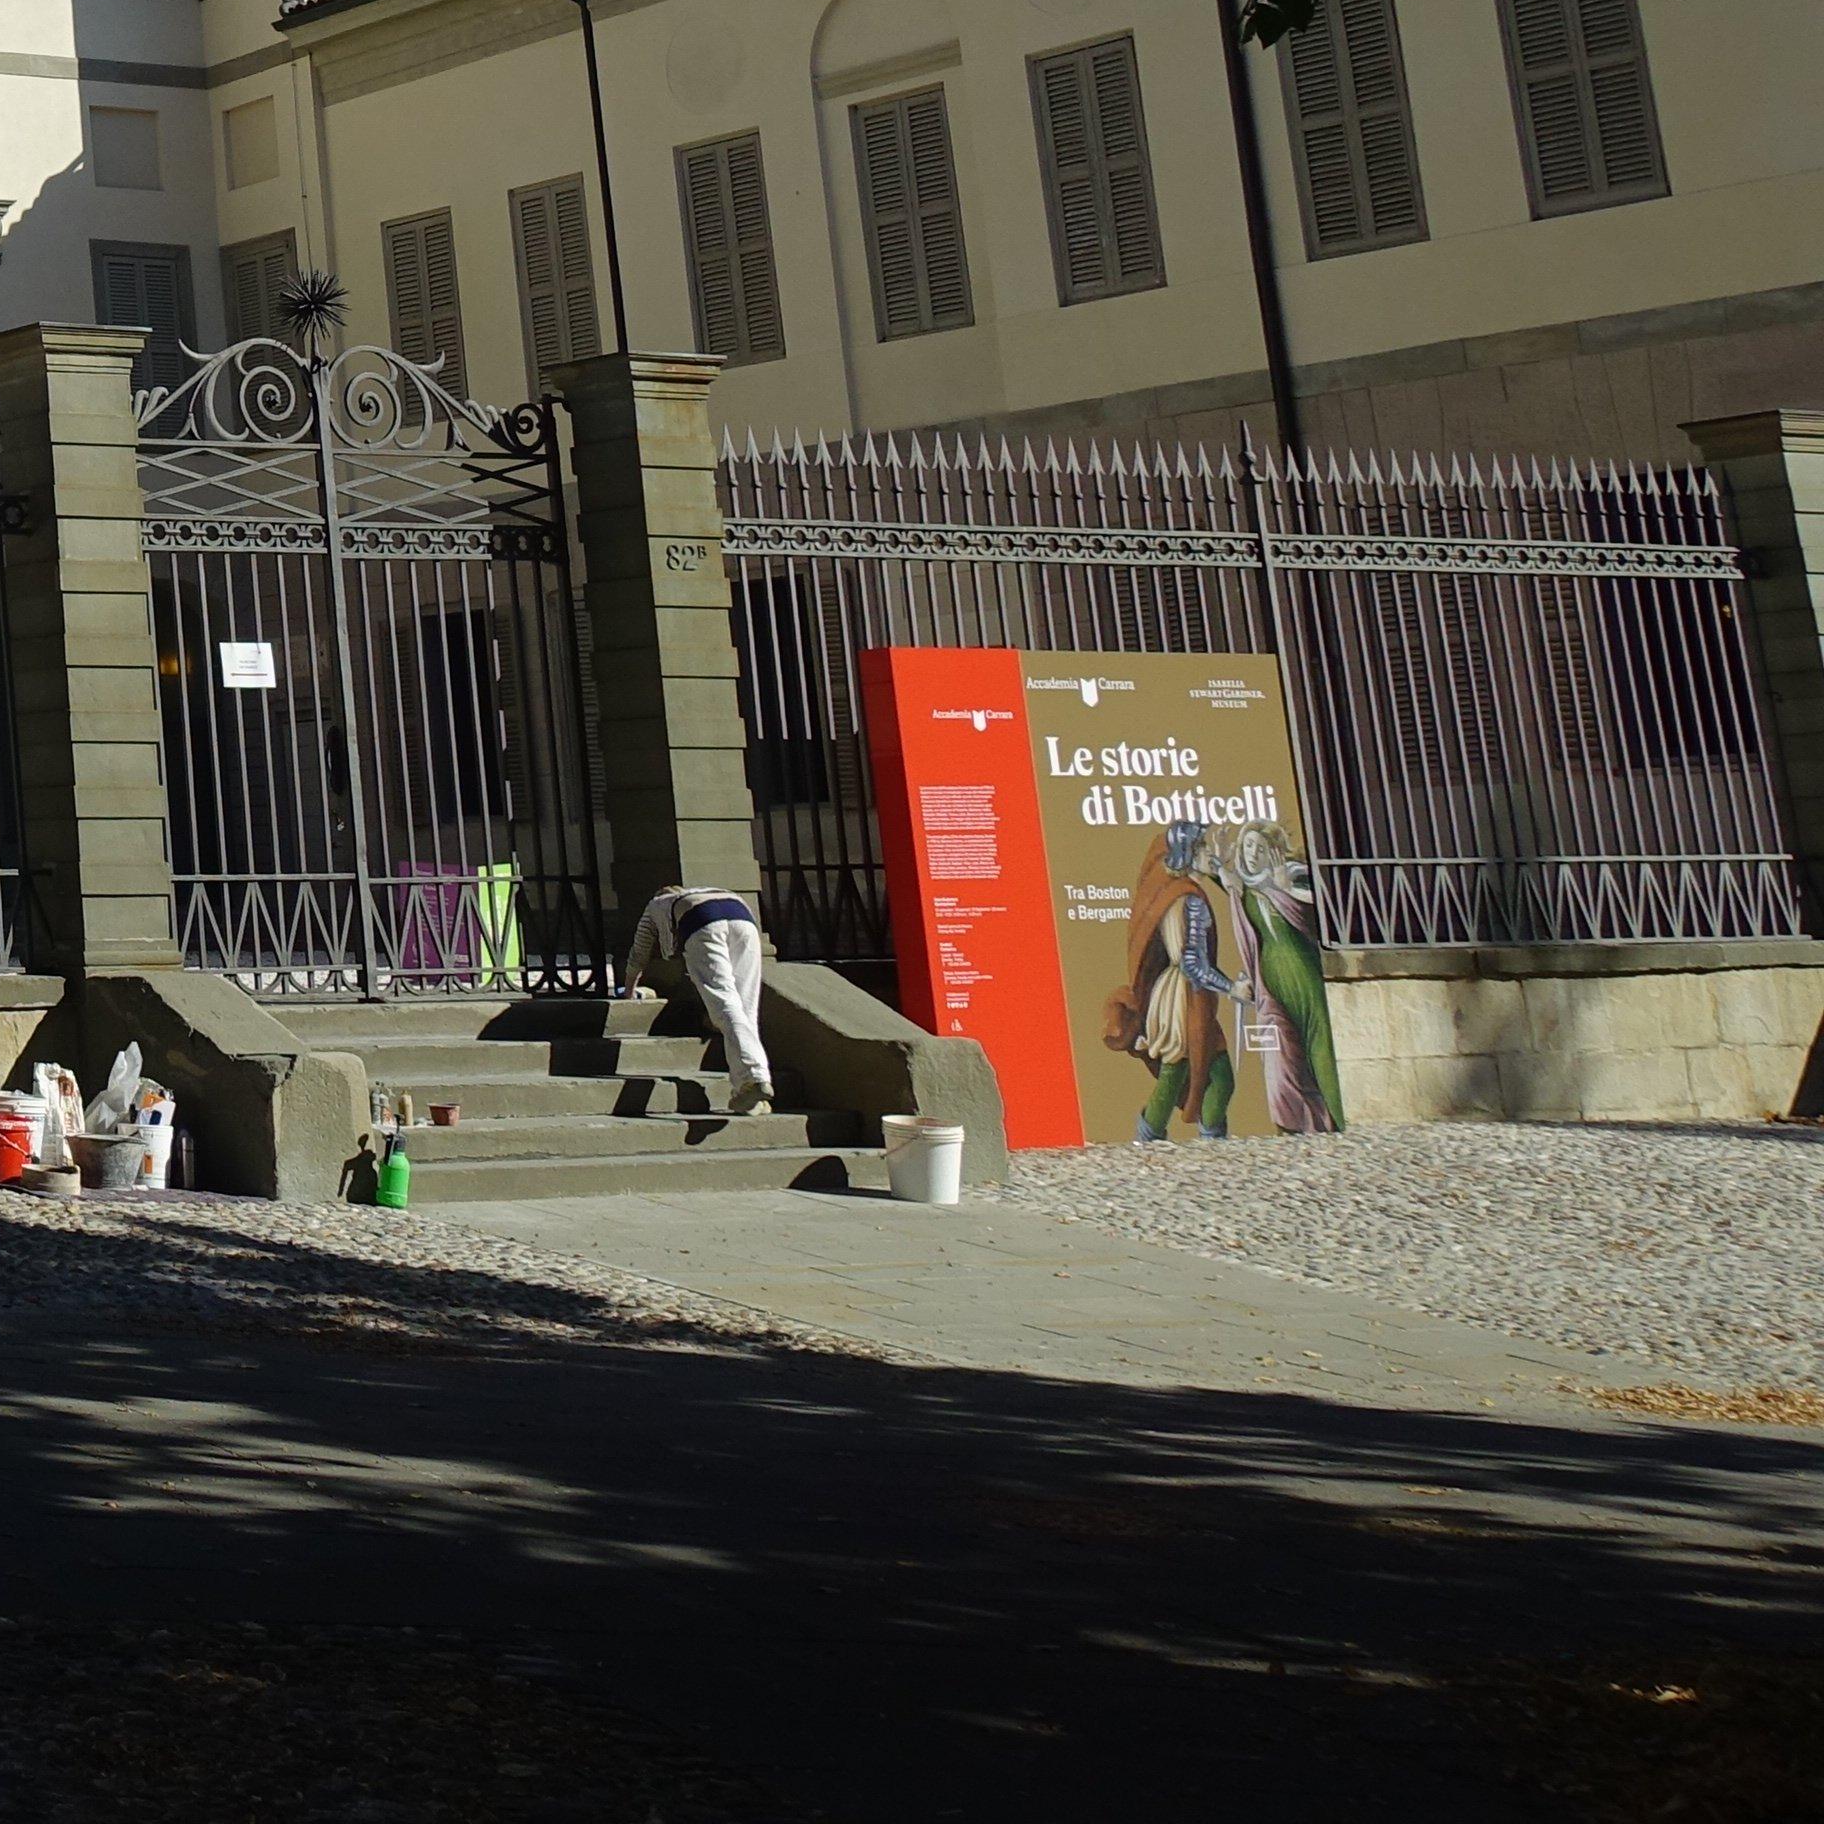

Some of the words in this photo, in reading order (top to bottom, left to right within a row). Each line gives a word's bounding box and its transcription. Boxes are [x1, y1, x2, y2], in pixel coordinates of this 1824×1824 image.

[1026, 676, 1078, 690] Accademia
[1098, 676, 1136, 691] Carrara
[932, 708, 972, 719] Accademia
[986, 709, 1014, 720] Carrara
[1045, 736, 1094, 776] Le
[1101, 736, 1200, 777] storie
[1082, 785, 1118, 825] di
[1121, 785, 1278, 826] Botticelli
[1064, 885, 1085, 901] Tra
[1087, 885, 1130, 901] Boston
[1068, 908, 1076, 920] e
